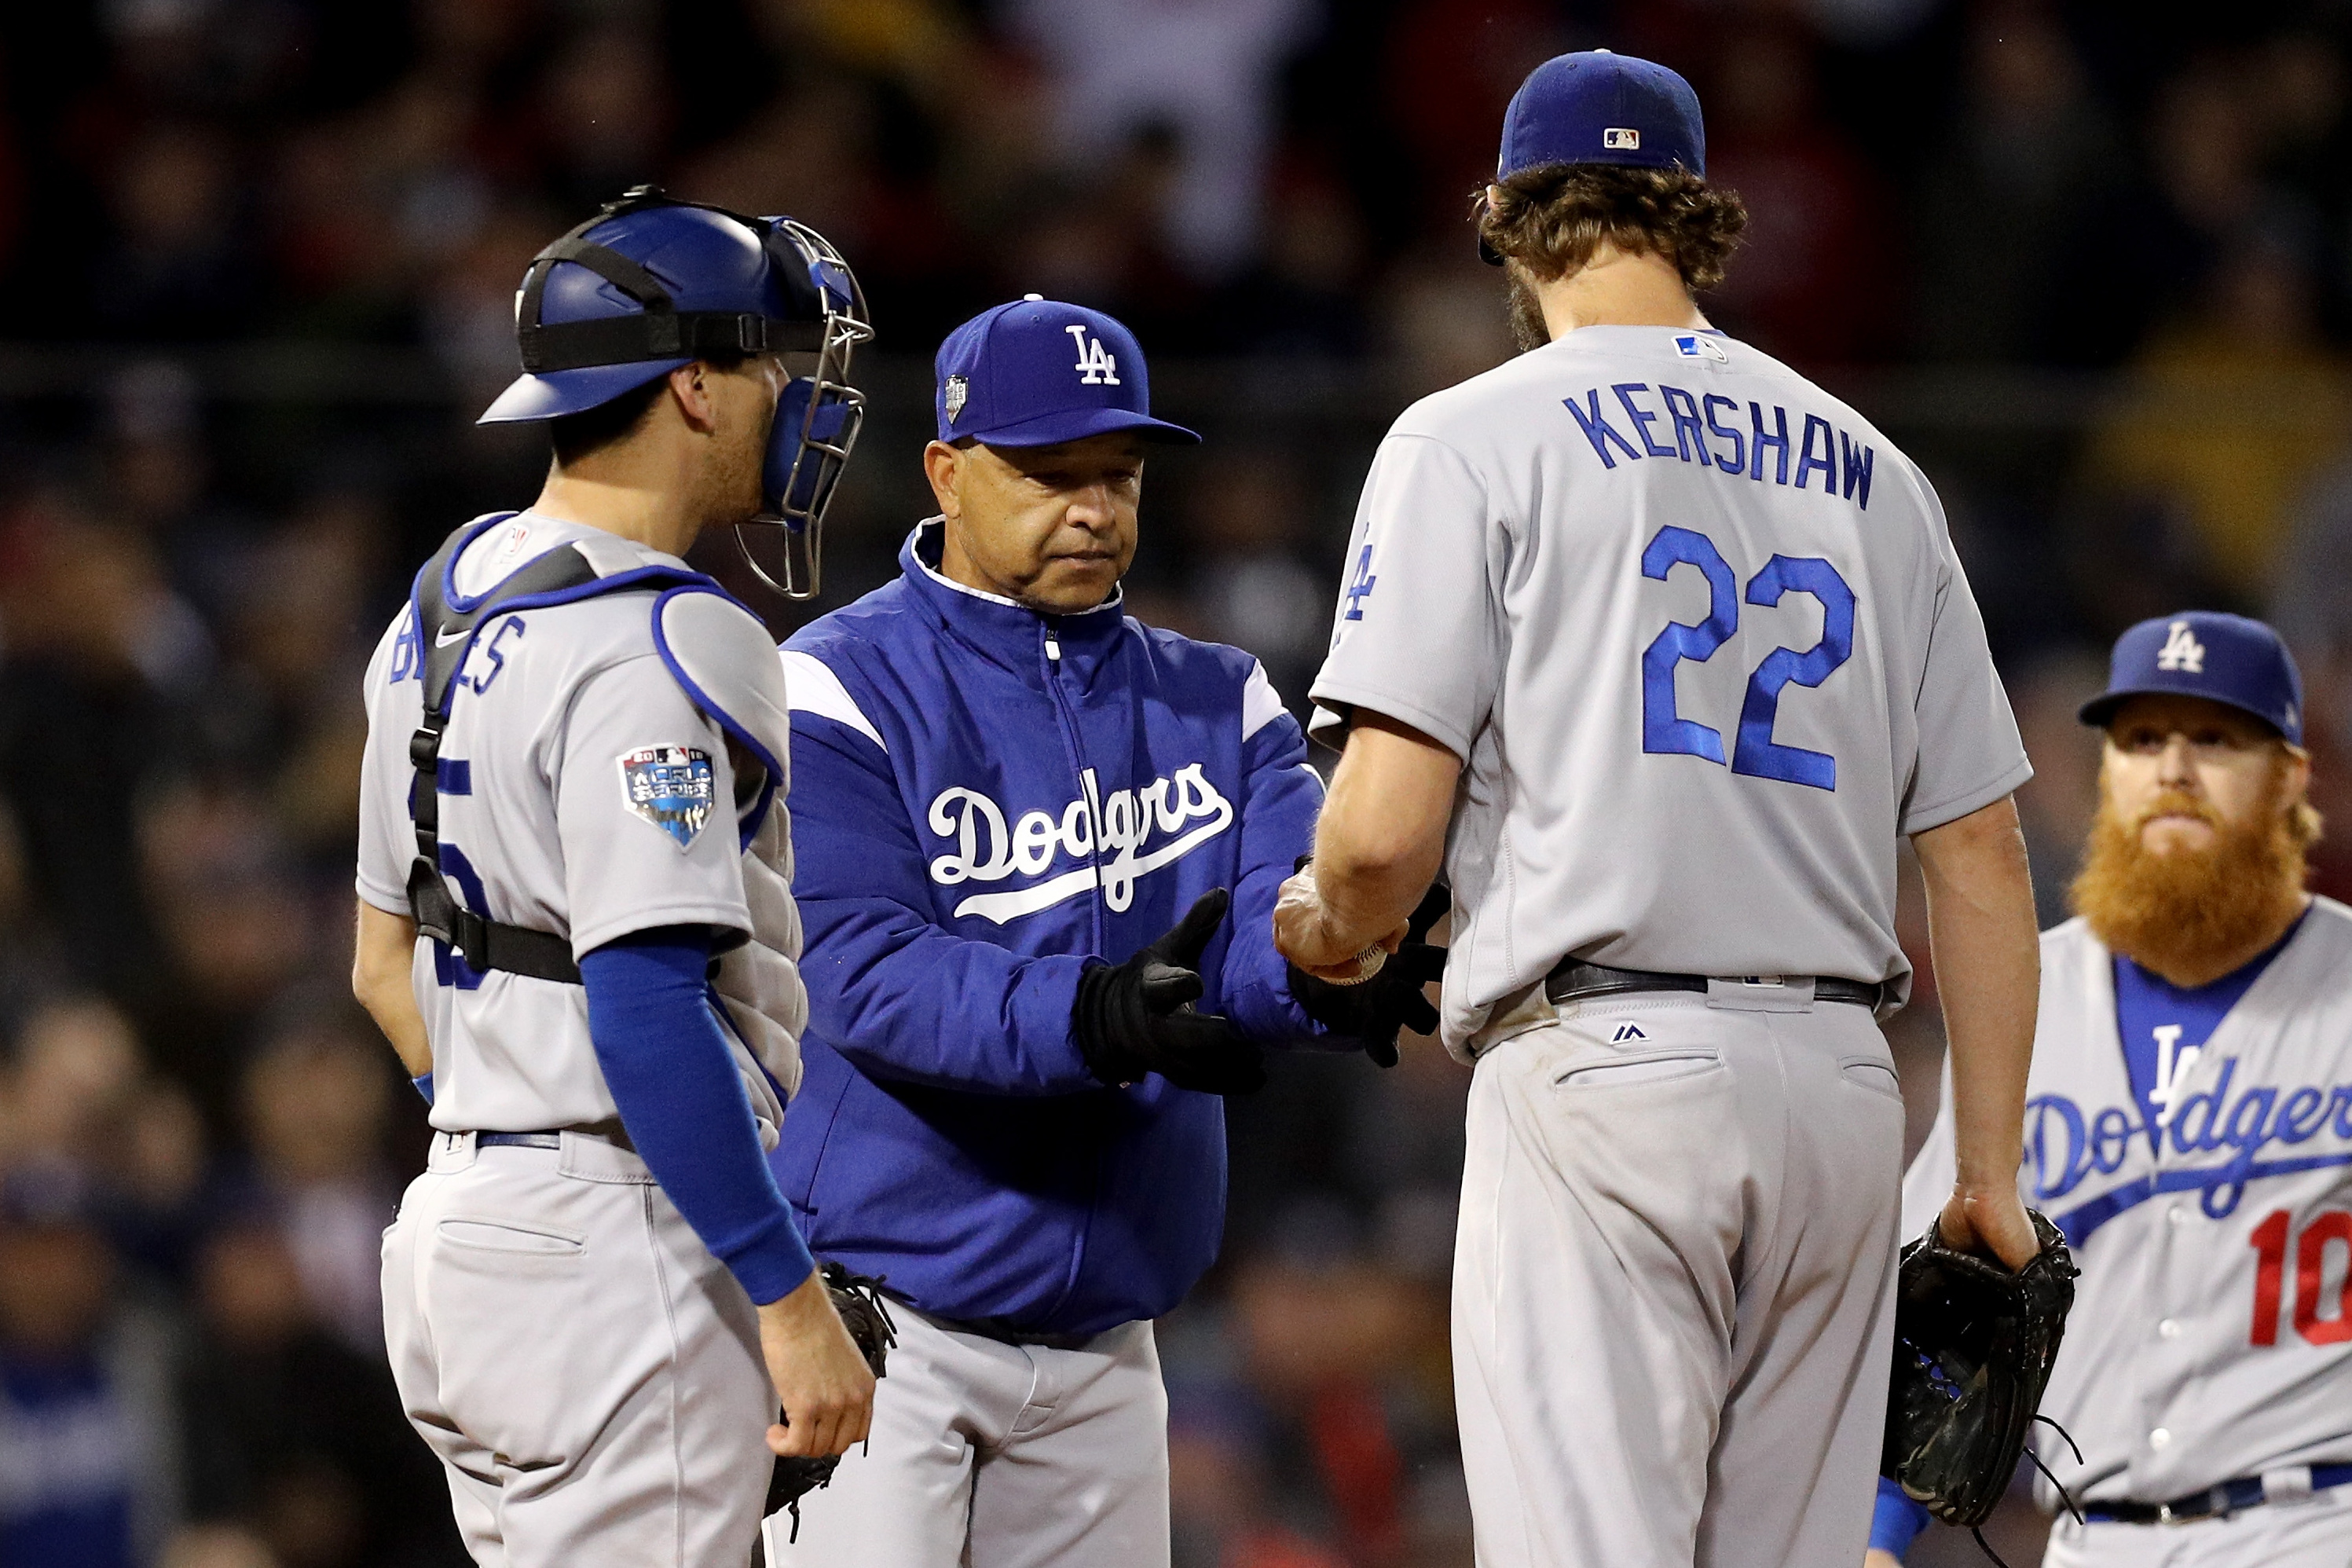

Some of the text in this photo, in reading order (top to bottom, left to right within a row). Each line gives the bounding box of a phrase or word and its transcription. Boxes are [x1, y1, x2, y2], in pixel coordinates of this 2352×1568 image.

[1065, 324, 1121, 386] LA
[1561, 383, 1874, 511] KERSHAW
[1641, 524, 1857, 793] 22
[2157, 620, 2206, 674] LA
[929, 763, 1234, 914] Dodgrs
[2248, 1210, 2352, 1348] 10
